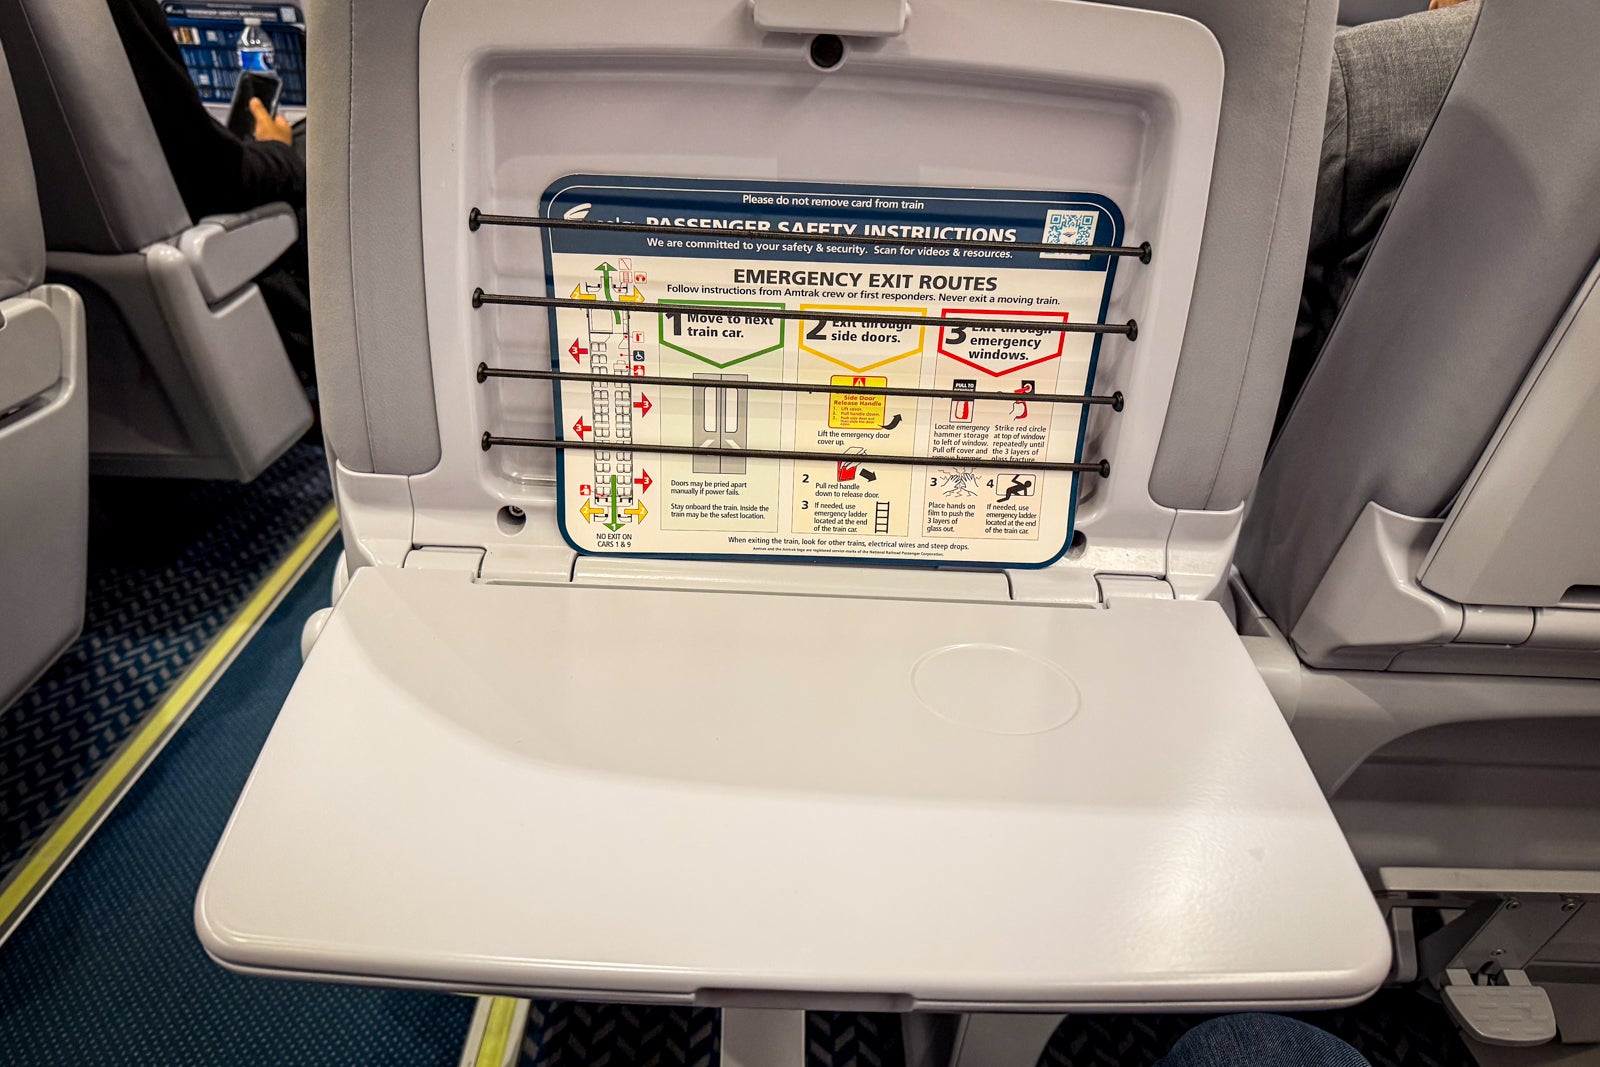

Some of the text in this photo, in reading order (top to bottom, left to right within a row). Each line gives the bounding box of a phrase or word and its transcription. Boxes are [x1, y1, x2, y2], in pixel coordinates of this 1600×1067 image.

[742, 195, 924, 209] Please do not remove card from train
[646, 217, 771, 231] PASSENGER
[778, 222, 857, 235] SAFETY
[864, 225, 1017, 242] INSTRUCTIONS
[647, 238, 664, 246] We
[686, 240, 739, 249] committed
[756, 243, 779, 252] your
[782, 243, 813, 253] safety
[816, 244, 823, 252] &
[826, 244, 868, 255] security.
[874, 246, 896, 255] Scan
[900, 246, 915, 255] for
[918, 247, 950, 256] videos
[953, 248, 960, 257] &
[963, 250, 1013, 258] resources.
[734, 269, 997, 291] EMERGENCY EXIT ROUTES
[667, 285, 699, 293] Follow
[702, 286, 756, 295] instructions
[759, 288, 781, 296] from
[784, 289, 820, 297] Amtrak
[882, 293, 936, 301] responders.
[939, 294, 966, 302] Never
[998, 296, 1033, 306] moving
[666, 313, 681, 335] 1
[688, 314, 722, 323] Move
[745, 316, 773, 325] next
[687, 327, 743, 338] train car.
[807, 320, 828, 340] 2
[832, 330, 900, 342] side doors.
[946, 326, 967, 344] 3
[970, 337, 1041, 349] emergency
[969, 349, 1028, 360] windows.
[802, 474, 809, 483] 2
[930, 478, 937, 486] 3
[987, 480, 994, 488] 4
[671, 503, 684, 511] Stay
[802, 501, 808, 509] 3
[950, 543, 969, 551] drops.
